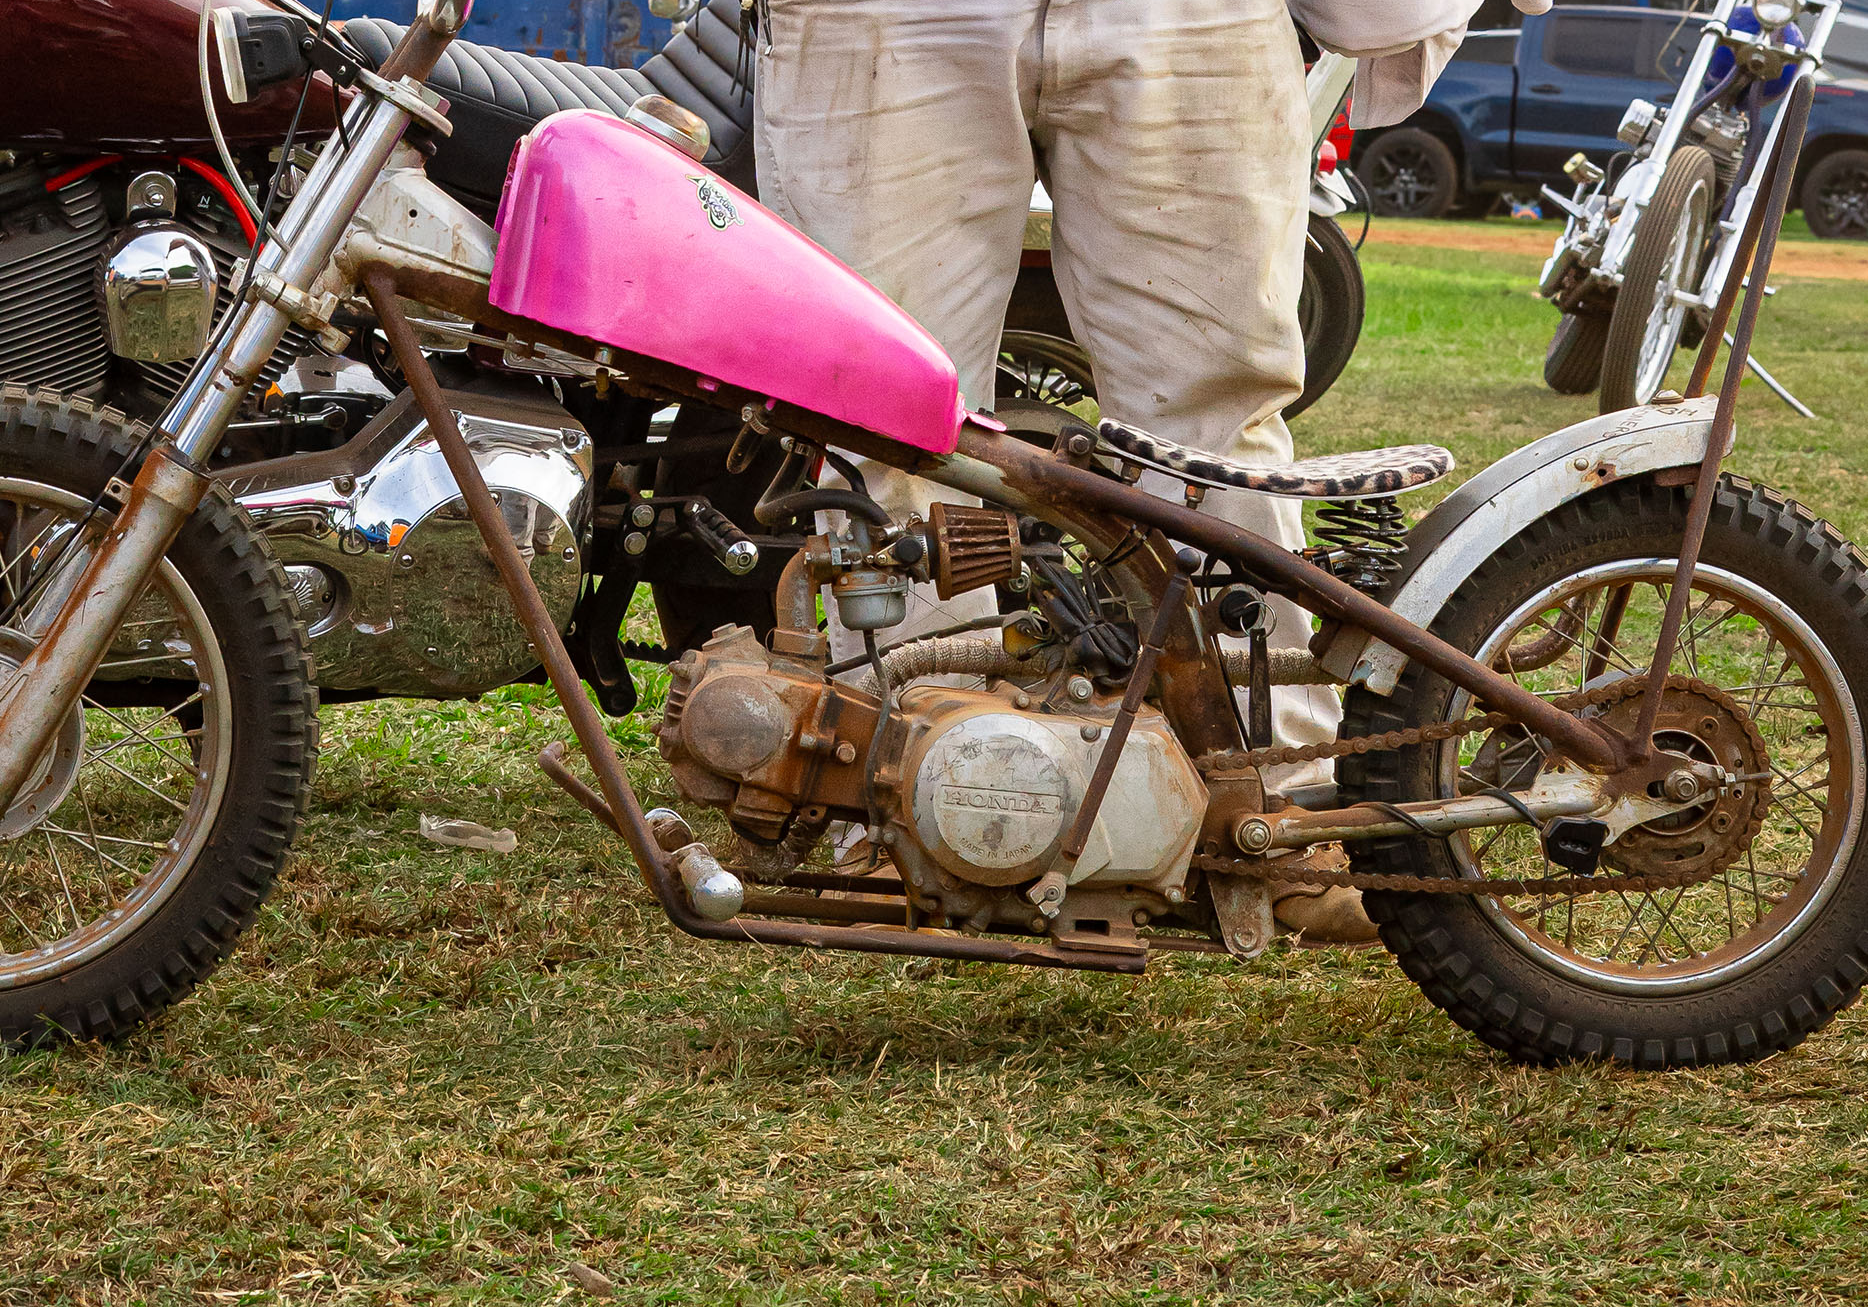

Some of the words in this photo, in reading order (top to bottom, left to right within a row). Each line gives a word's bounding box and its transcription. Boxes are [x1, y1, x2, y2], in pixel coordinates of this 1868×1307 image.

[944, 790, 1055, 814] HONDA
[960, 838, 985, 857] MADE
[987, 851, 998, 859] IN
[1003, 844, 1033, 860] JAPAN
